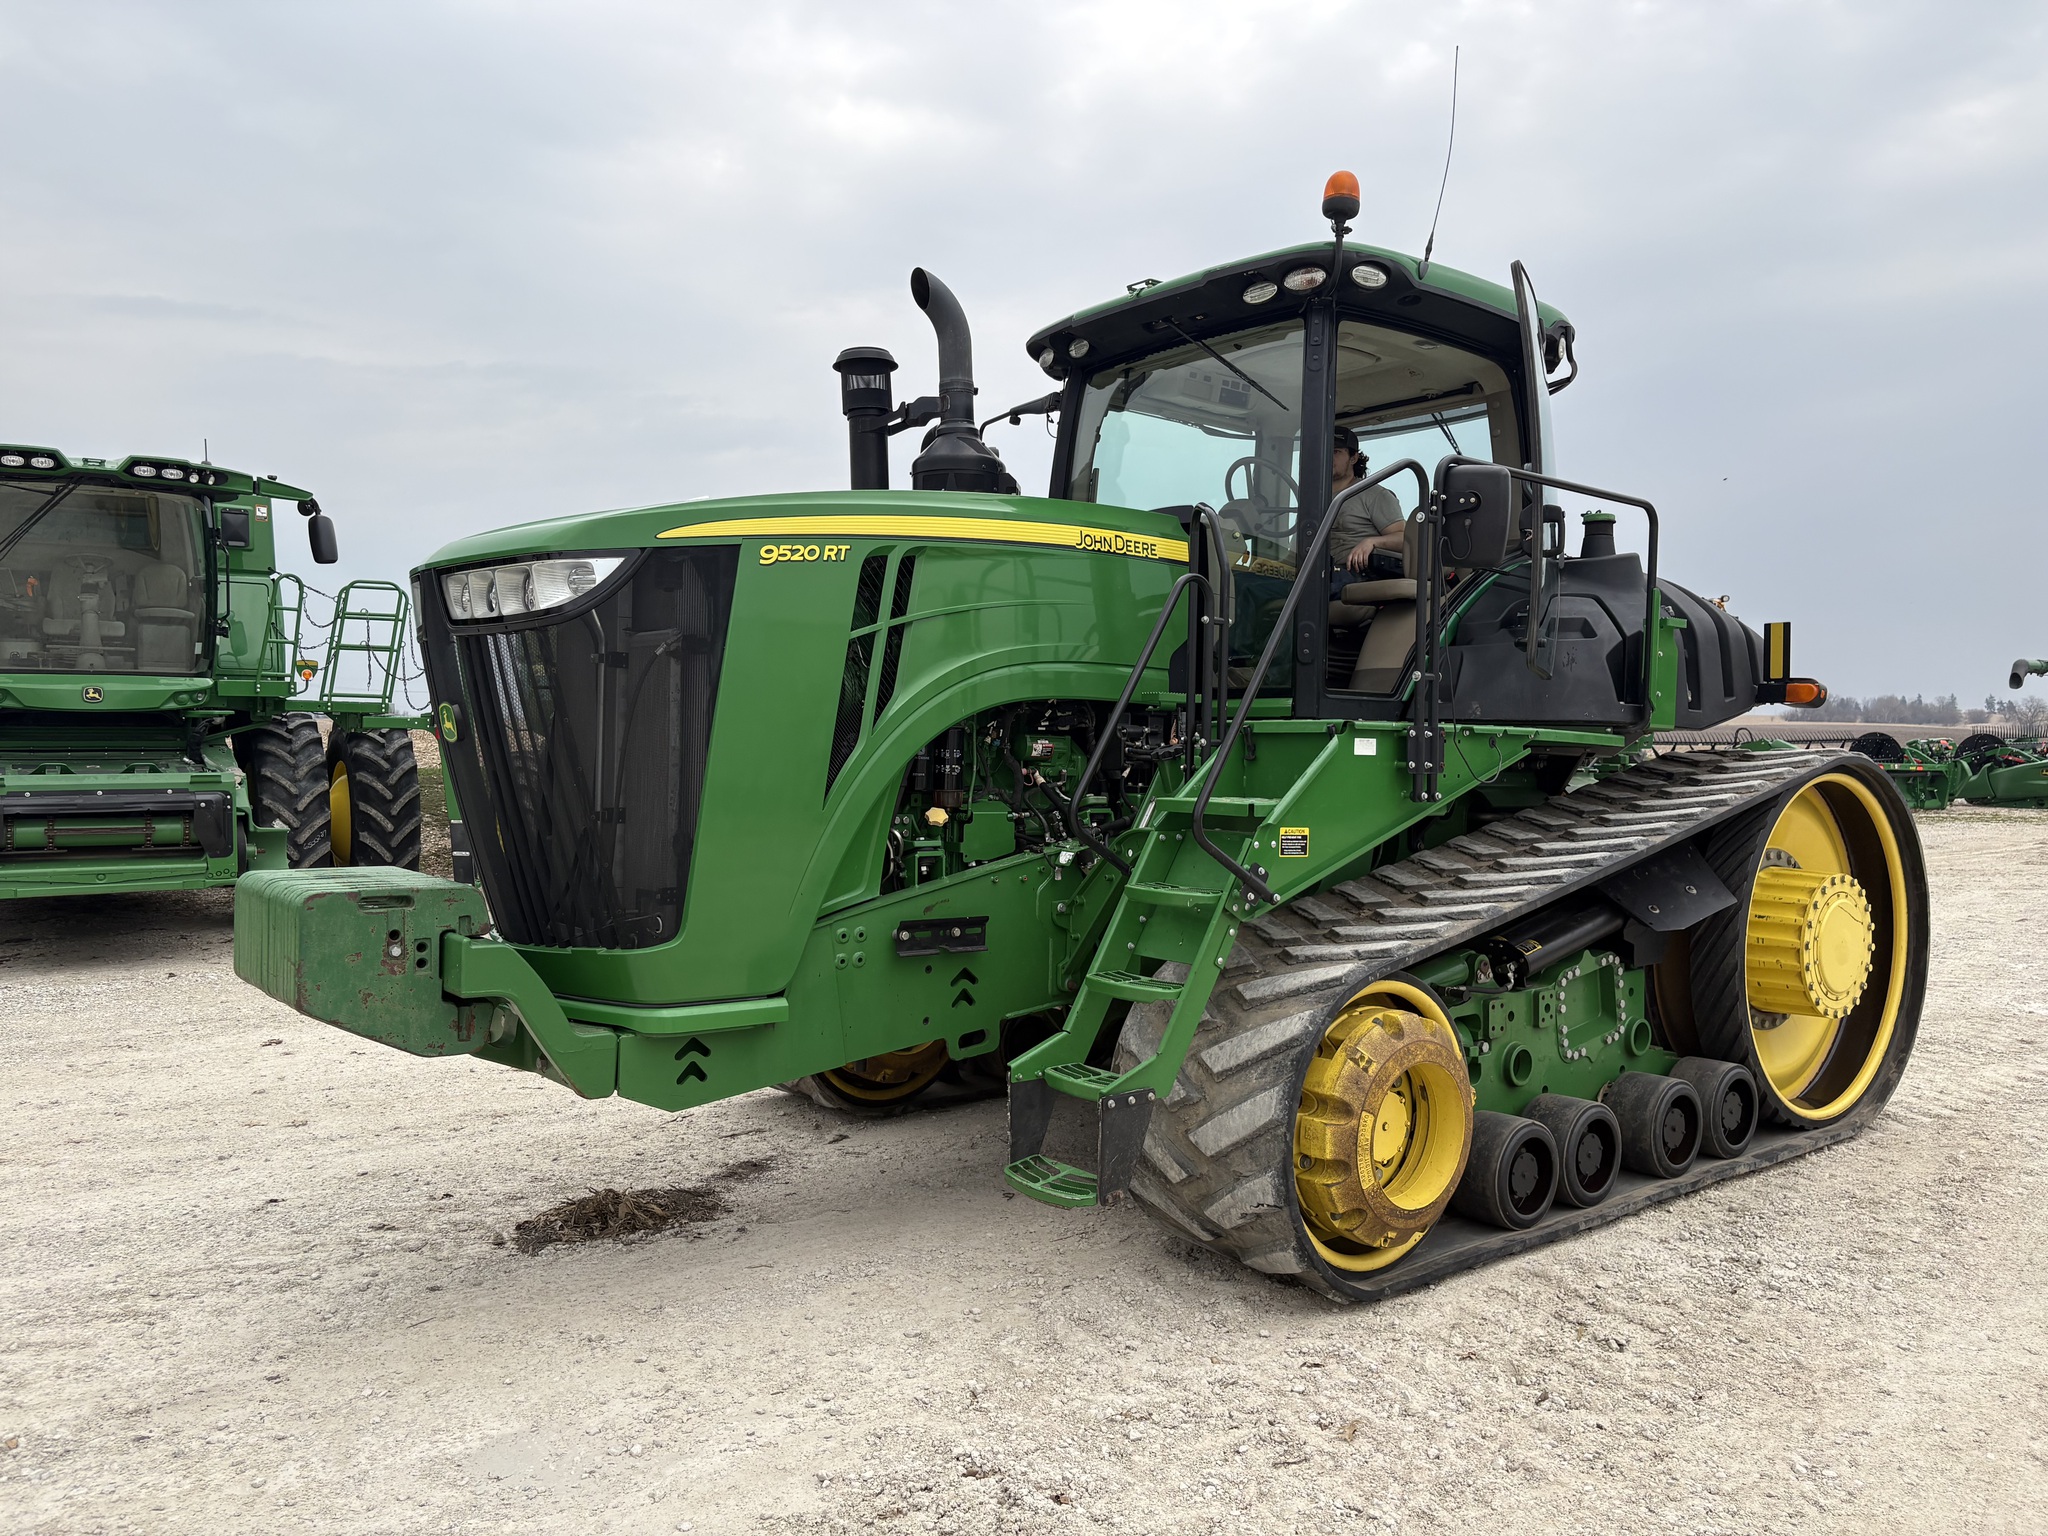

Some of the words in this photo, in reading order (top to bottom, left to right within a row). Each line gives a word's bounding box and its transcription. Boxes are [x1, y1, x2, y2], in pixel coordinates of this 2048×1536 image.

[759, 544, 820, 565] 9520
[822, 544, 851, 561] RT
[1075, 530, 1113, 550] JOHN
[1114, 534, 1158, 557] DEERE
